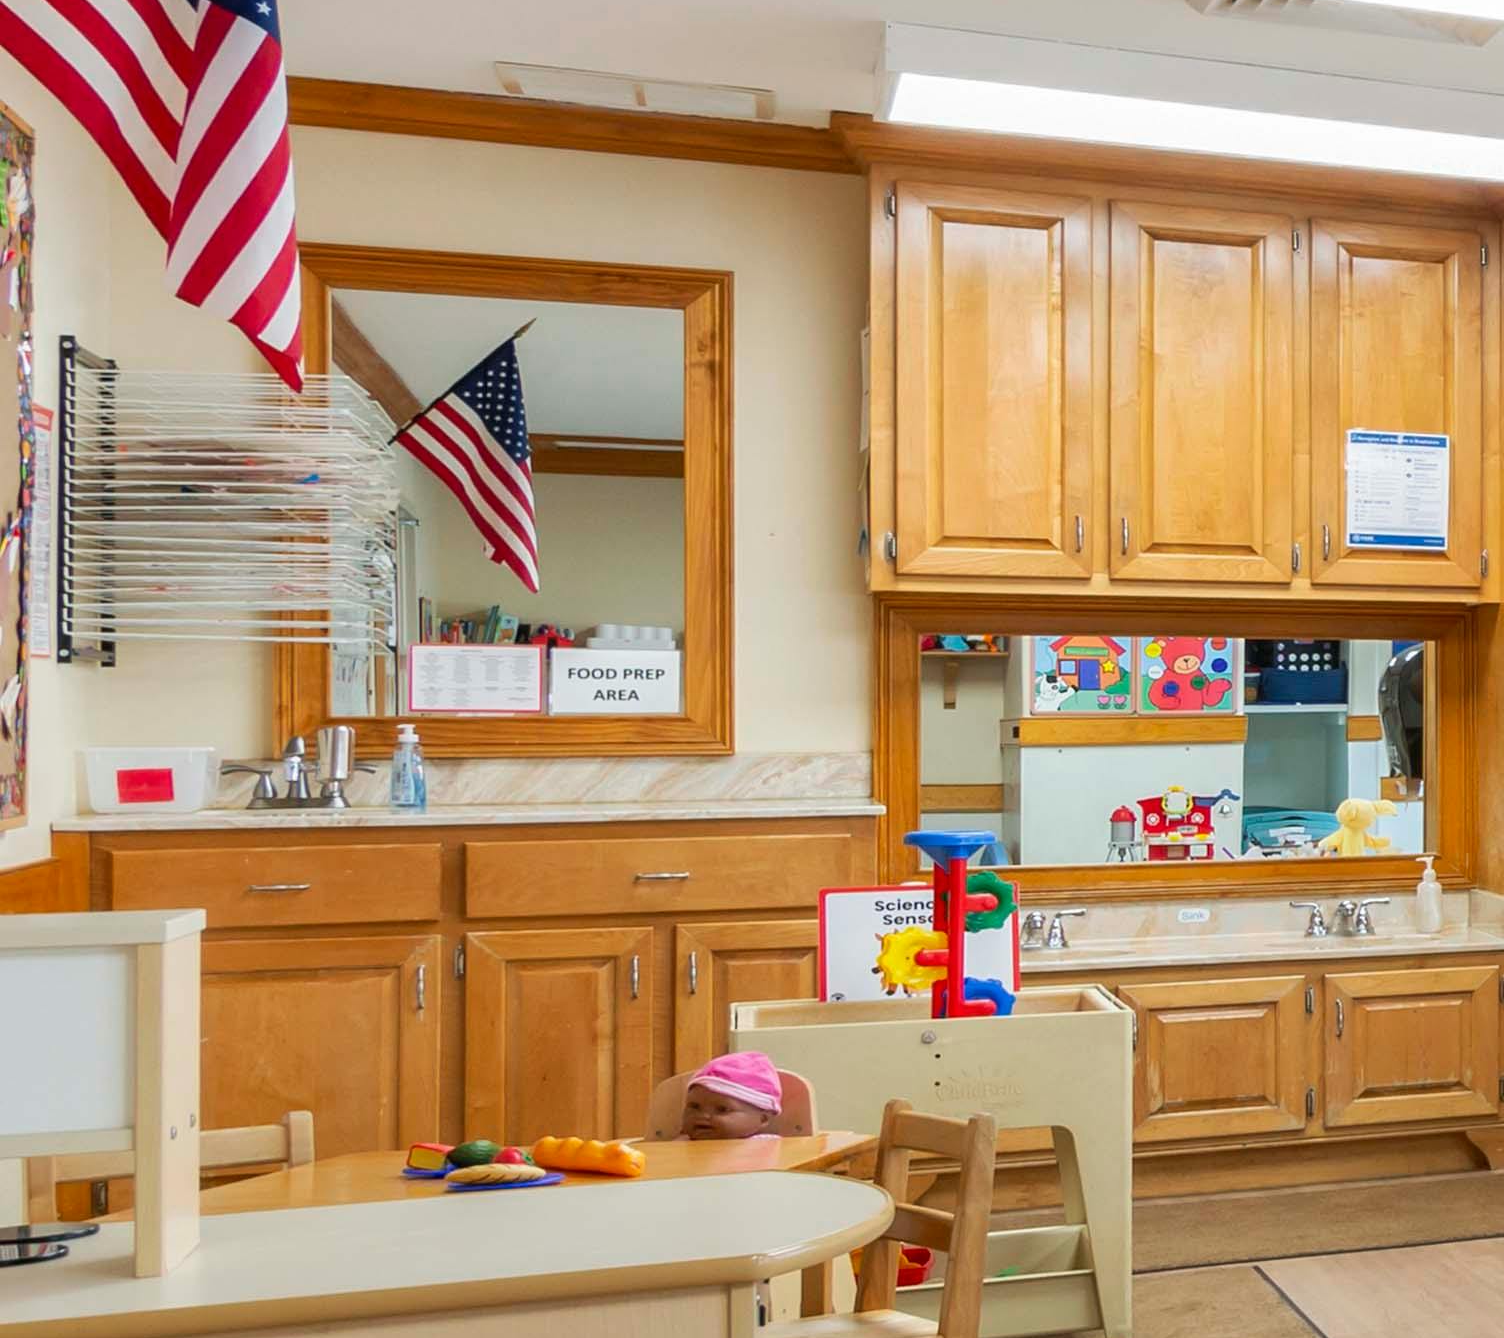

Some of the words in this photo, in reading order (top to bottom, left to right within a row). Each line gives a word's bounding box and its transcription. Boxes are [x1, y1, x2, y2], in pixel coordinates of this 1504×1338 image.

[568, 667, 617, 680] FOOD
[623, 668, 665, 680] PREP
[593, 689, 640, 701] AREA
[875, 898, 934, 912] Scienc
[883, 913, 934, 925] Senso
